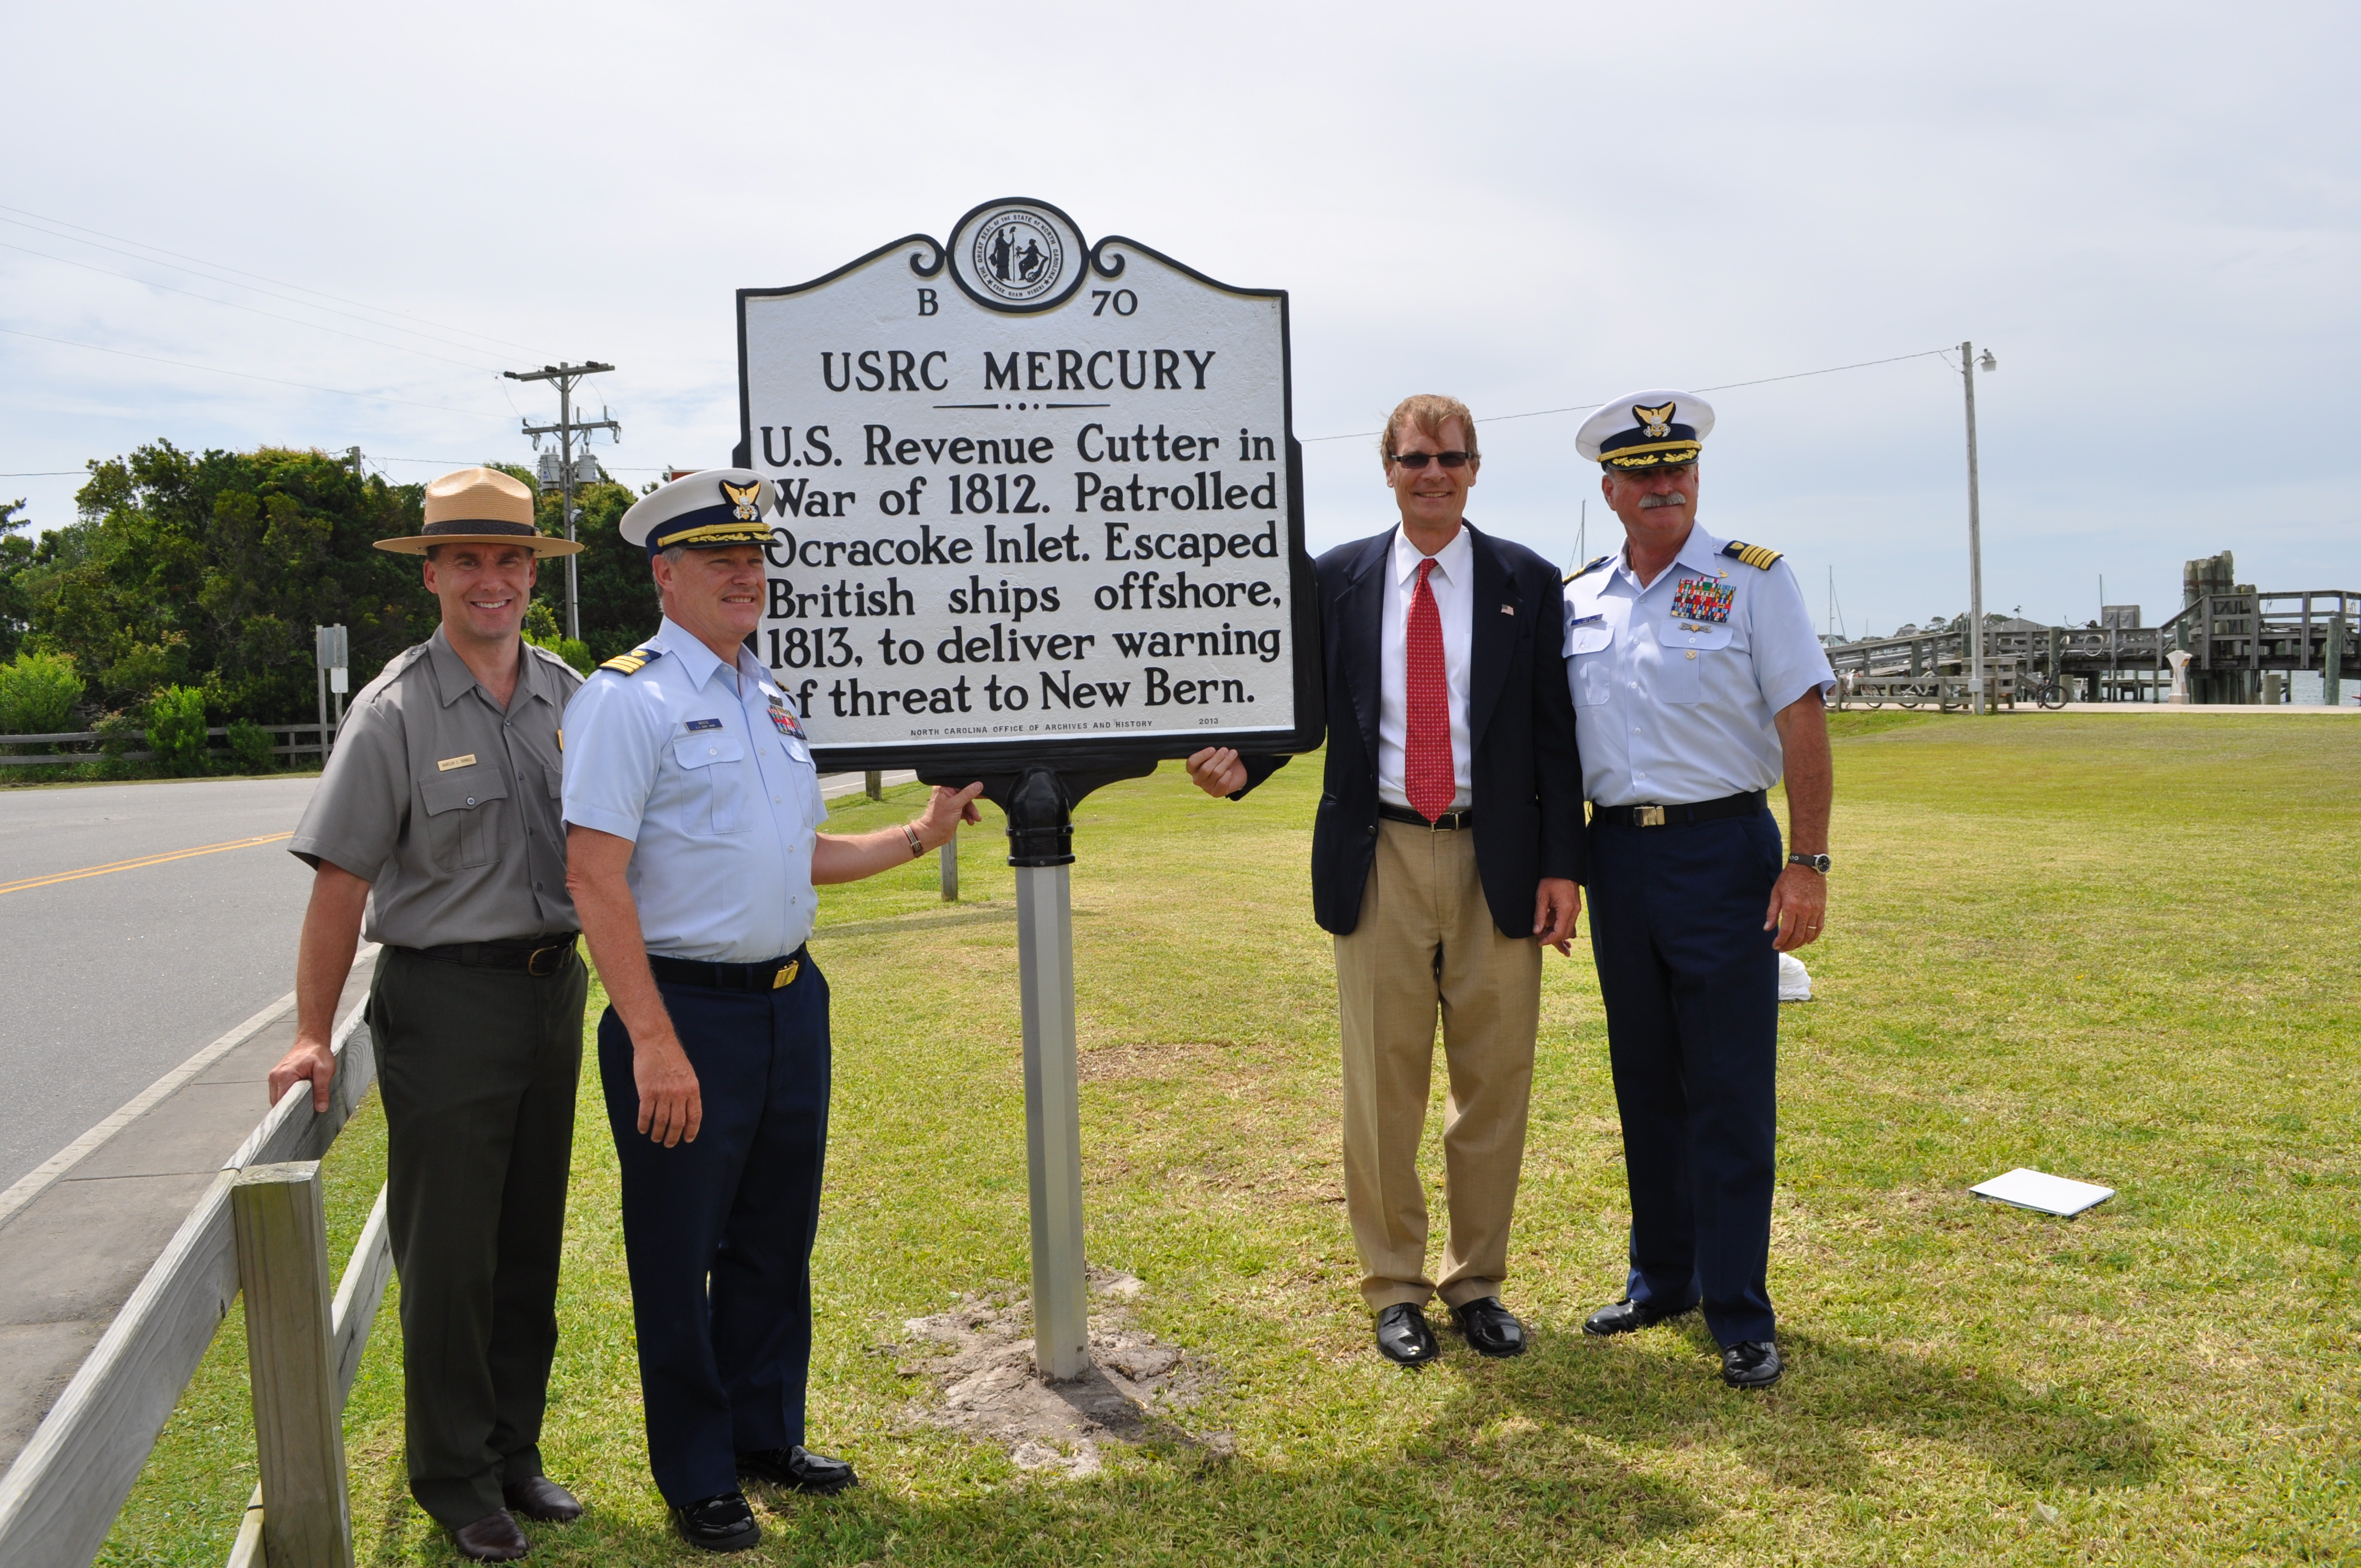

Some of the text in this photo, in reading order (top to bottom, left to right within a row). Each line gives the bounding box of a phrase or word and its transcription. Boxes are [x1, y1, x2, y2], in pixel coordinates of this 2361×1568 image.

[981, 225, 993, 240] SEAL
[1013, 214, 1032, 223] STATE
[1041, 225, 1056, 245] NORTH
[979, 266, 989, 279] THE
[1049, 249, 1059, 280] CAROLINA
[917, 288, 1138, 315] B 70
[993, 284, 1005, 293] ESSE
[1027, 285, 1045, 295] VIDERI
[821, 350, 1216, 391] USRC MERCURY
[760, 423, 1276, 467] U.S. Revenue Cutter in
[770, 471, 1277, 518] War of 1812. Patrolled
[765, 520, 1279, 567] Ocracoke Inlet. Escaped
[767, 571, 1280, 622] British ships offshore,
[768, 623, 1281, 669] 1813, to deliver warning
[786, 667, 1254, 718] f threat to New Bern.
[1045, 722, 1087, 731] ARCHIVES
